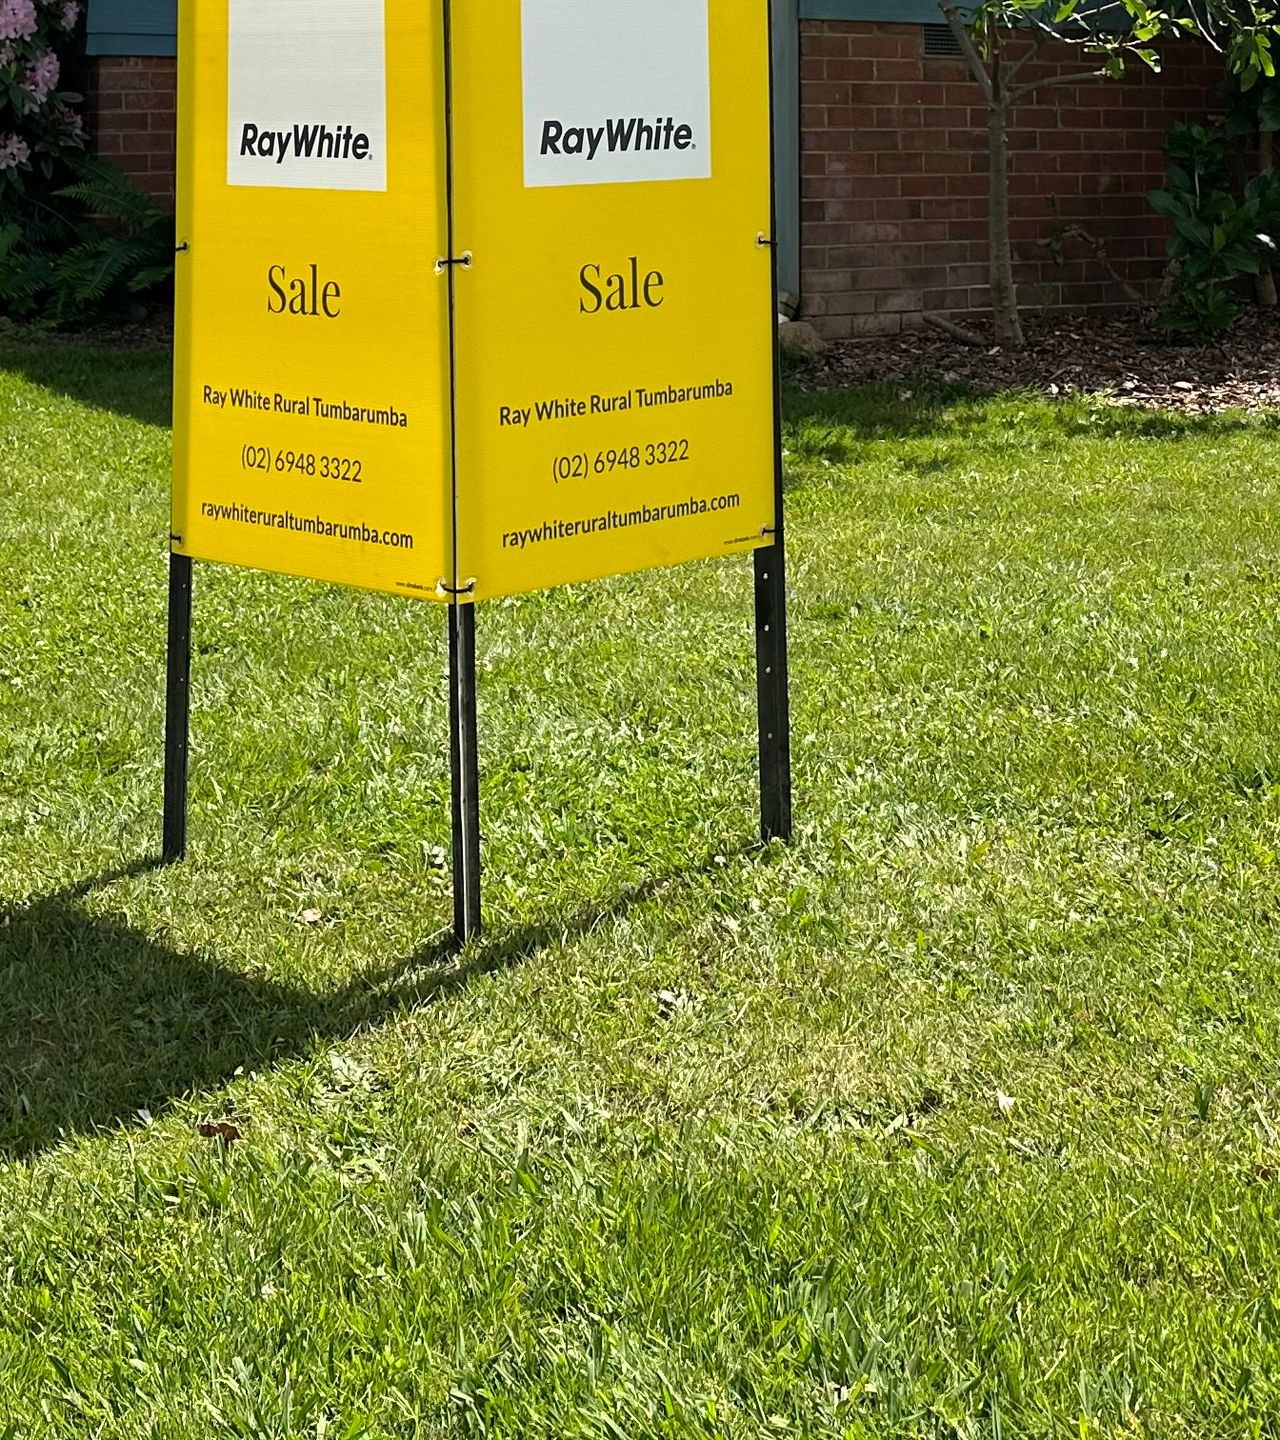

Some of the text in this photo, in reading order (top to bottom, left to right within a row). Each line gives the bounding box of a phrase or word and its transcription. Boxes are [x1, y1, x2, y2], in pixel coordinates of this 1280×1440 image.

[267, 263, 341, 319] Sale
[579, 256, 665, 314] Sale
[203, 385, 408, 428] Ray White Rural Tumbarumba
[499, 379, 733, 427] Ray White Rural Tumbarumba
[241, 444, 362, 483] (02) 6948 3322
[552, 438, 690, 484] (02) 6948 3322
[201, 501, 414, 549] raywhiteruraltumbarumba.com
[501, 493, 740, 549] raywhiteruraltumbarumba.com
